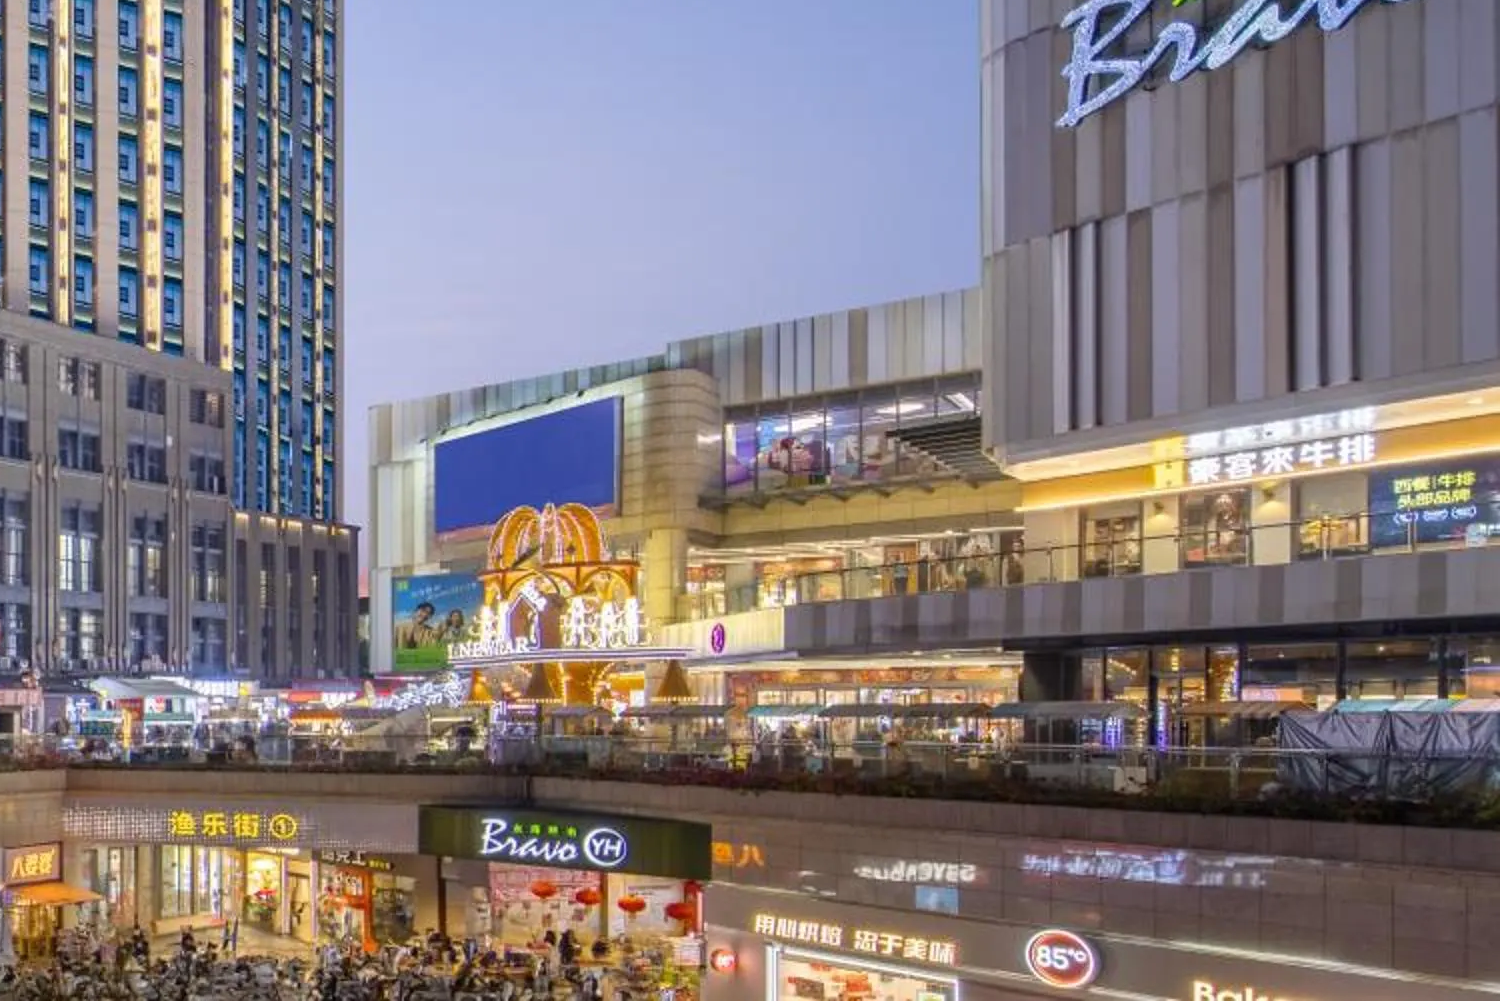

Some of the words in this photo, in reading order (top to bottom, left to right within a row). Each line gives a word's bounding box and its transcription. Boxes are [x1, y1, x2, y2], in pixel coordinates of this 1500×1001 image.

[171, 810, 261, 838] 渔乐街
[480, 818, 578, 861] Bravo
